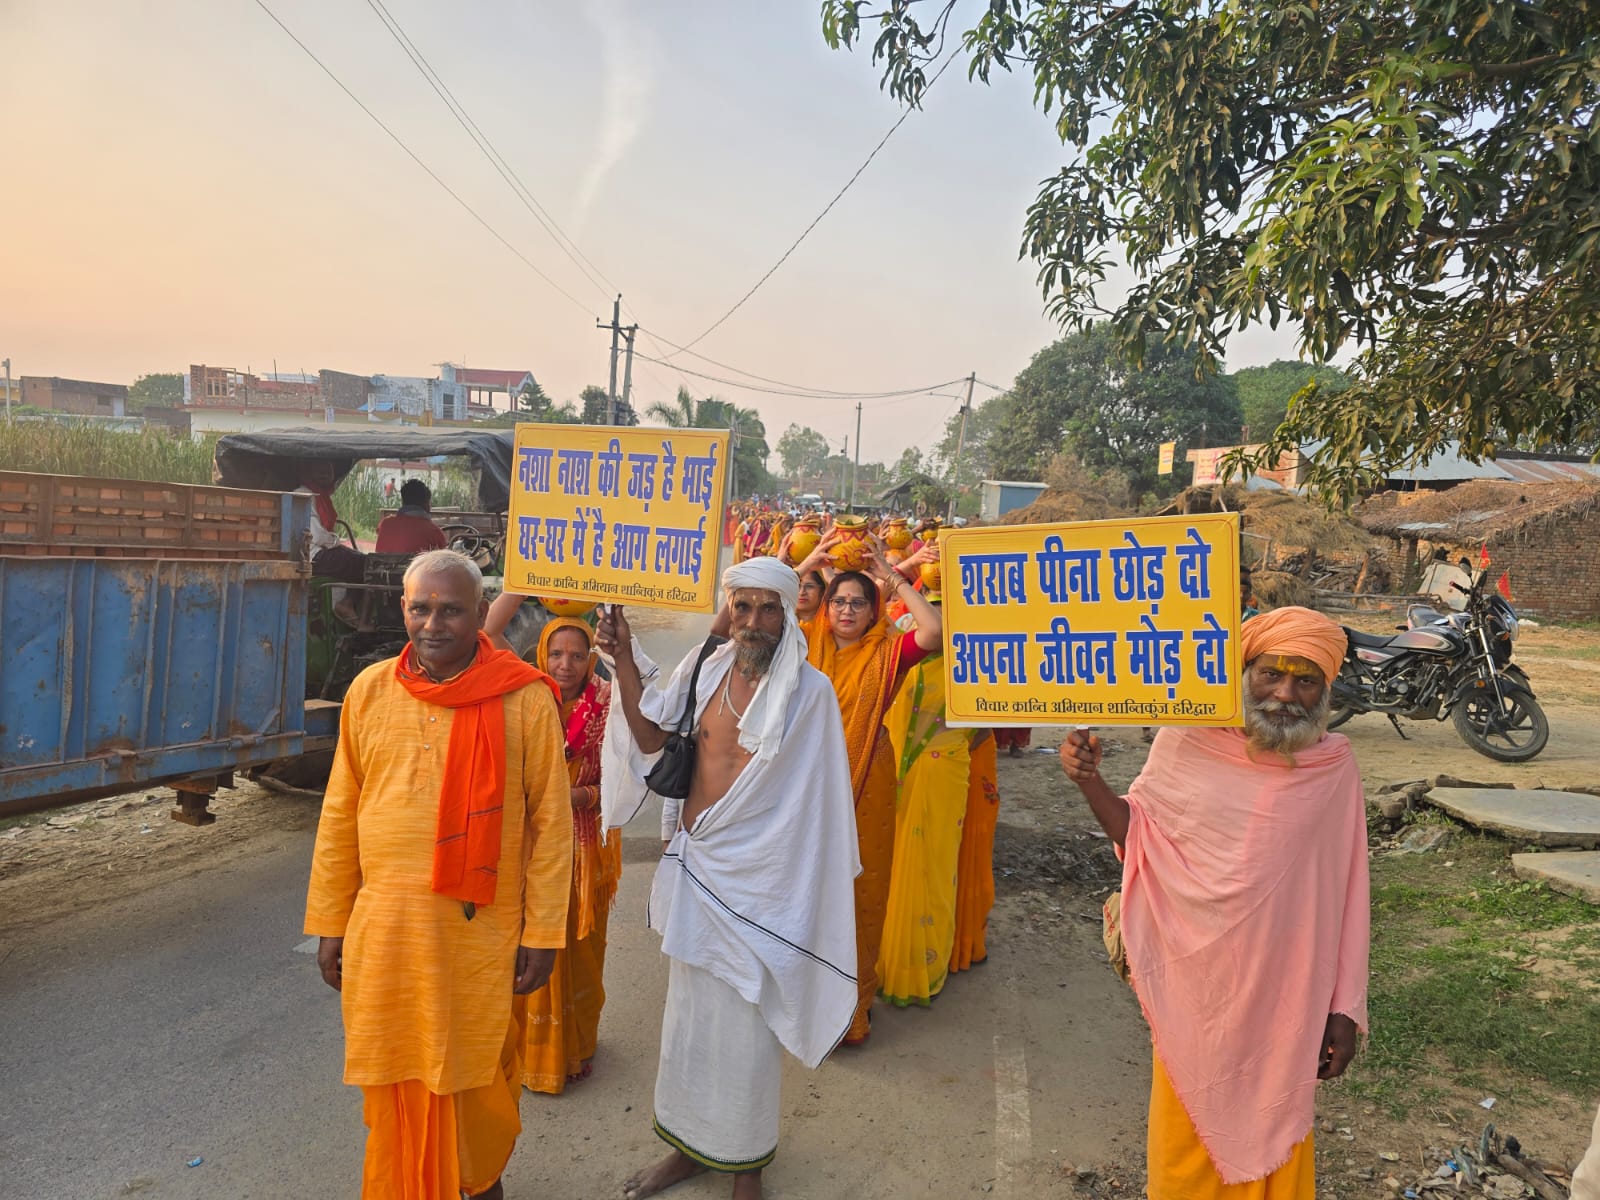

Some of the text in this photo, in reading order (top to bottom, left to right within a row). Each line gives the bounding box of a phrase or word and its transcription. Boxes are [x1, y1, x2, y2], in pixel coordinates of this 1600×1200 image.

[519, 438, 718, 512] नशा नाश की जड़ है भाई
[518, 507, 706, 583] घर-घर में है आग लगाई
[959, 528, 1212, 615] शराब पीना छोड़ दो
[952, 613, 1229, 700] अपना जीवन मोड़ दो
